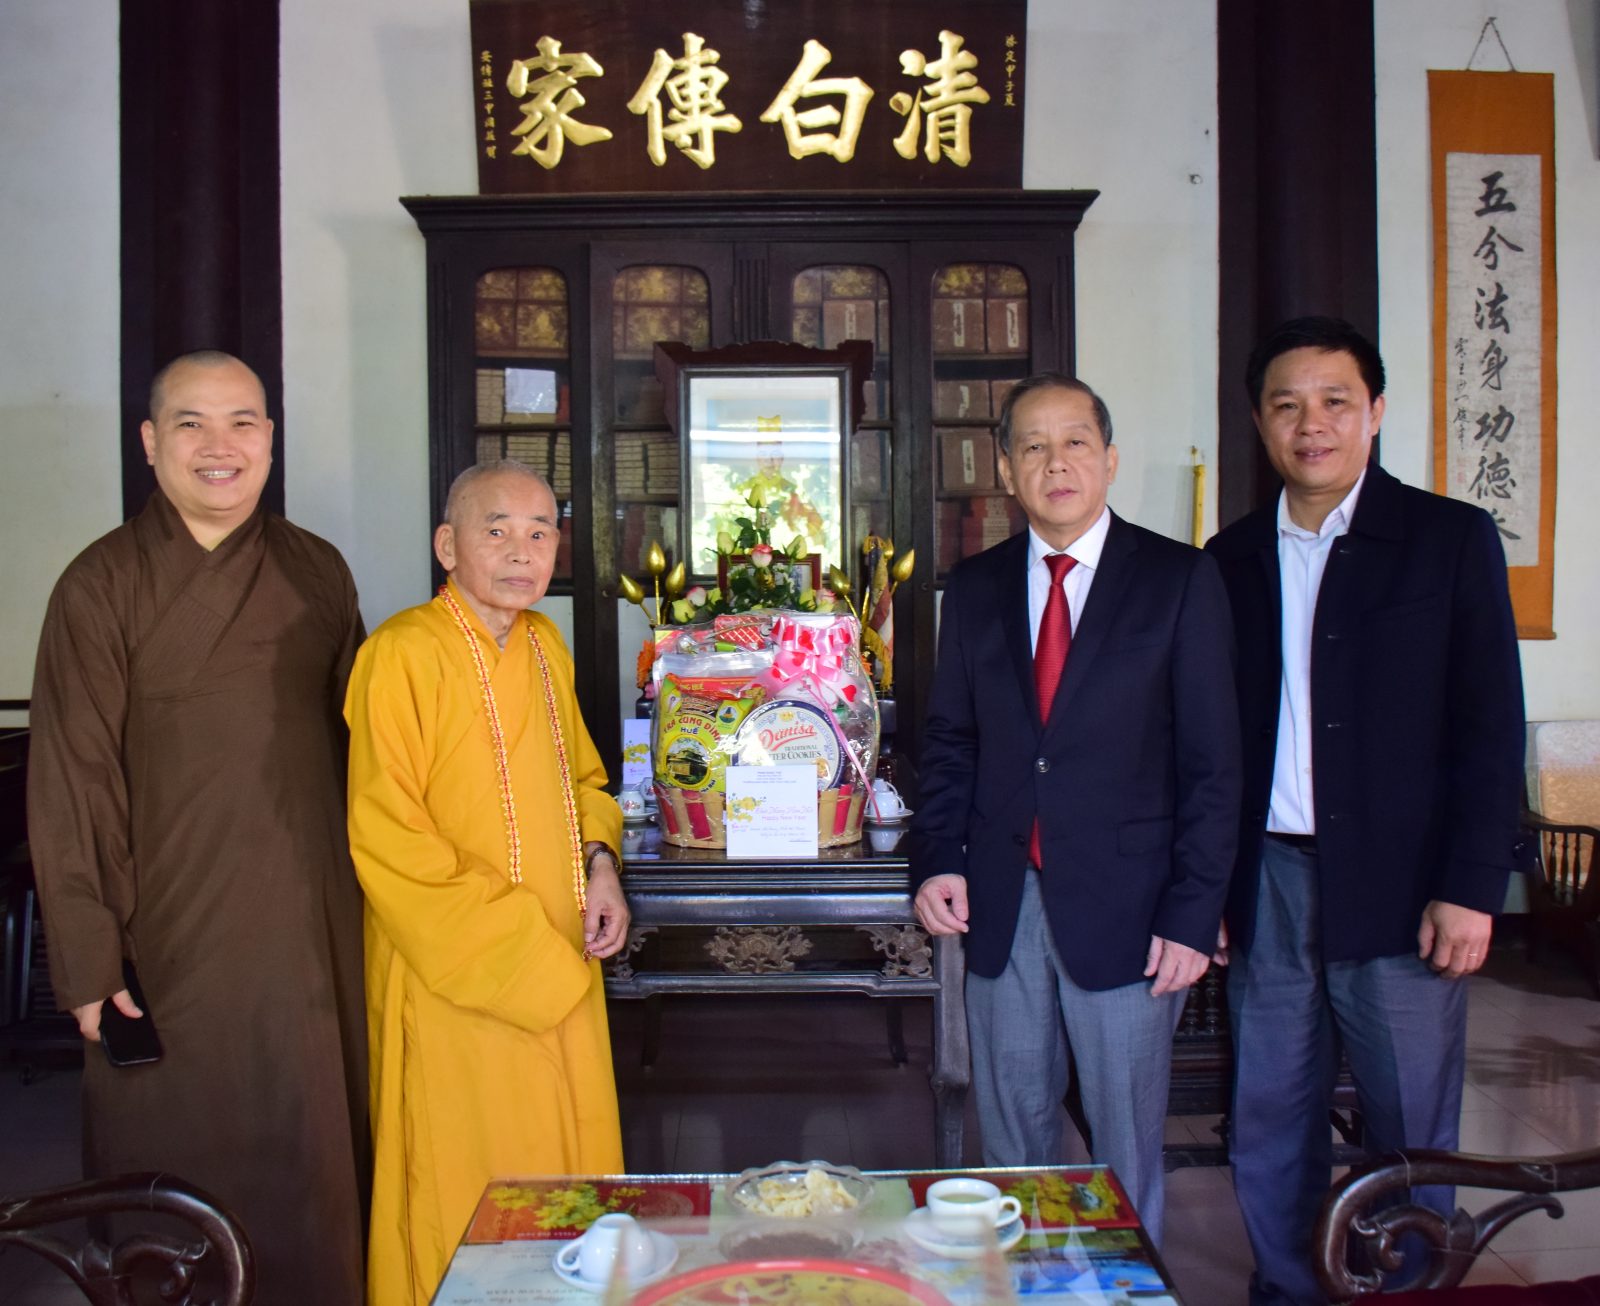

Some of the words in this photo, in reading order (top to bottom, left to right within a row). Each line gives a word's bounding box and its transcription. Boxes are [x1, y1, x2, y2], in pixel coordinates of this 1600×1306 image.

[506, 30, 990, 169] 清白傳家
[663, 717, 676, 734] TRÀ
[678, 715, 703, 726] CUNG
[680, 726, 700, 735] HUẾ
[758, 721, 817, 749] Danisa
[787, 750, 822, 760] COOKIES
